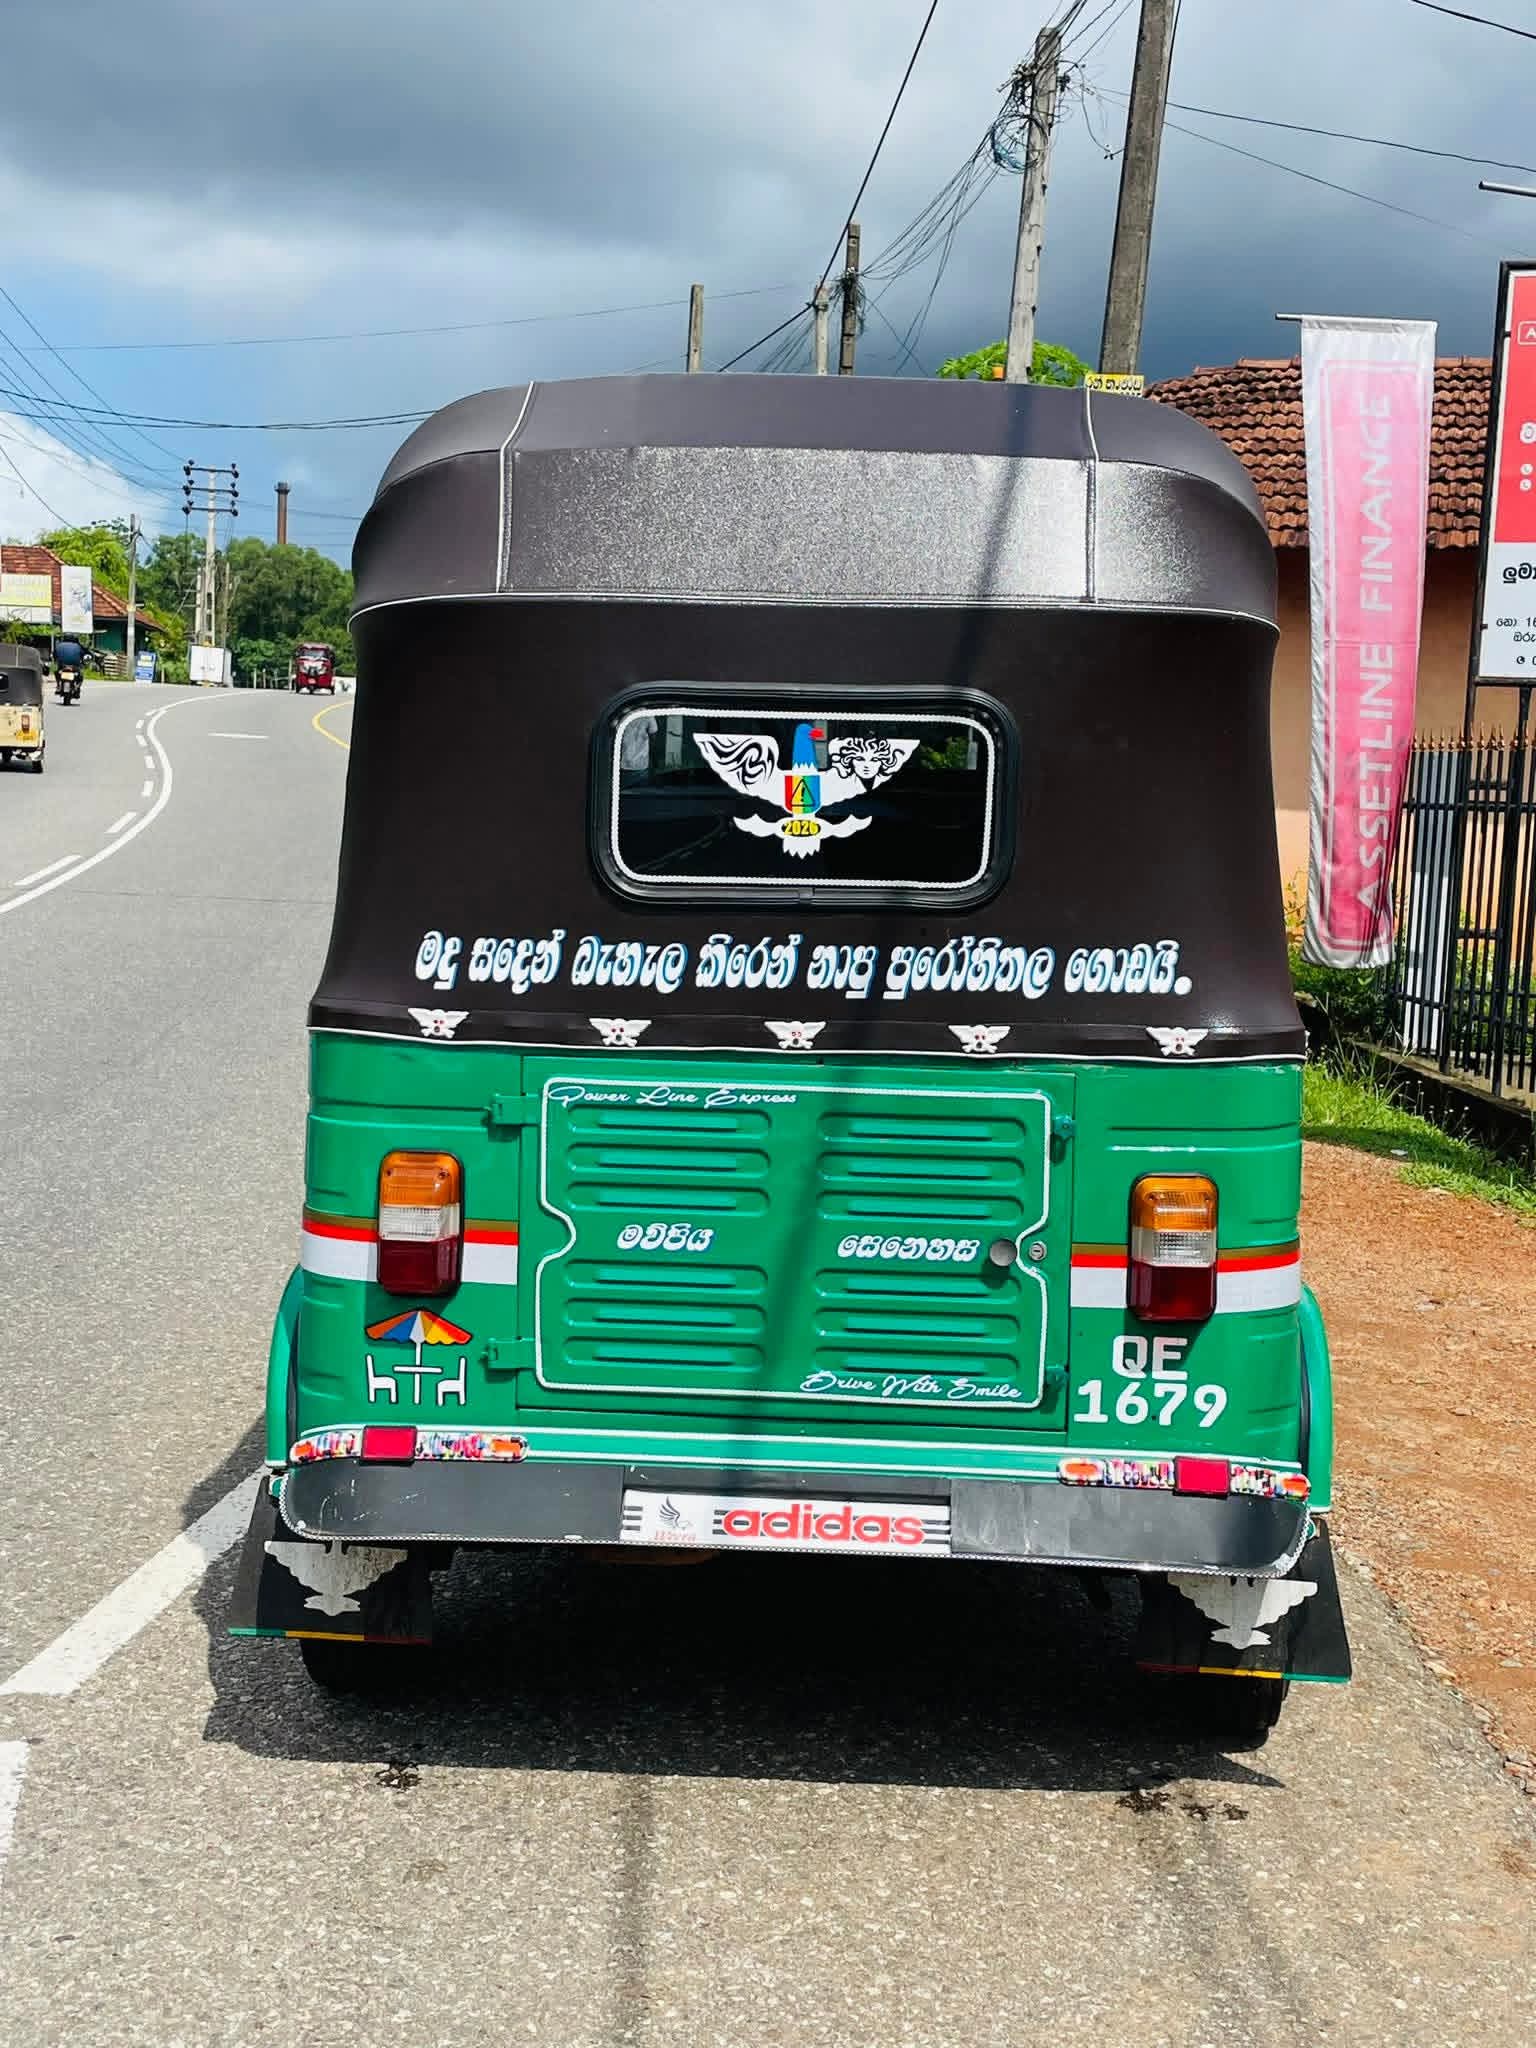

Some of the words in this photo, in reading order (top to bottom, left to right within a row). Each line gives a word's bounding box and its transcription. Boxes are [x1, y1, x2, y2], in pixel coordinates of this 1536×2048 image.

[1359, 391, 1393, 612] FINANCE
[549, 1085, 630, 1108] Power
[636, 1087, 699, 1106] Line
[704, 1087, 797, 1110] Express
[1112, 1335, 1189, 1380] QE
[800, 1370, 876, 1392] Drive
[882, 1374, 942, 1397] With
[1074, 1380, 1228, 1428] 1679
[722, 1503, 925, 1546] adidas
